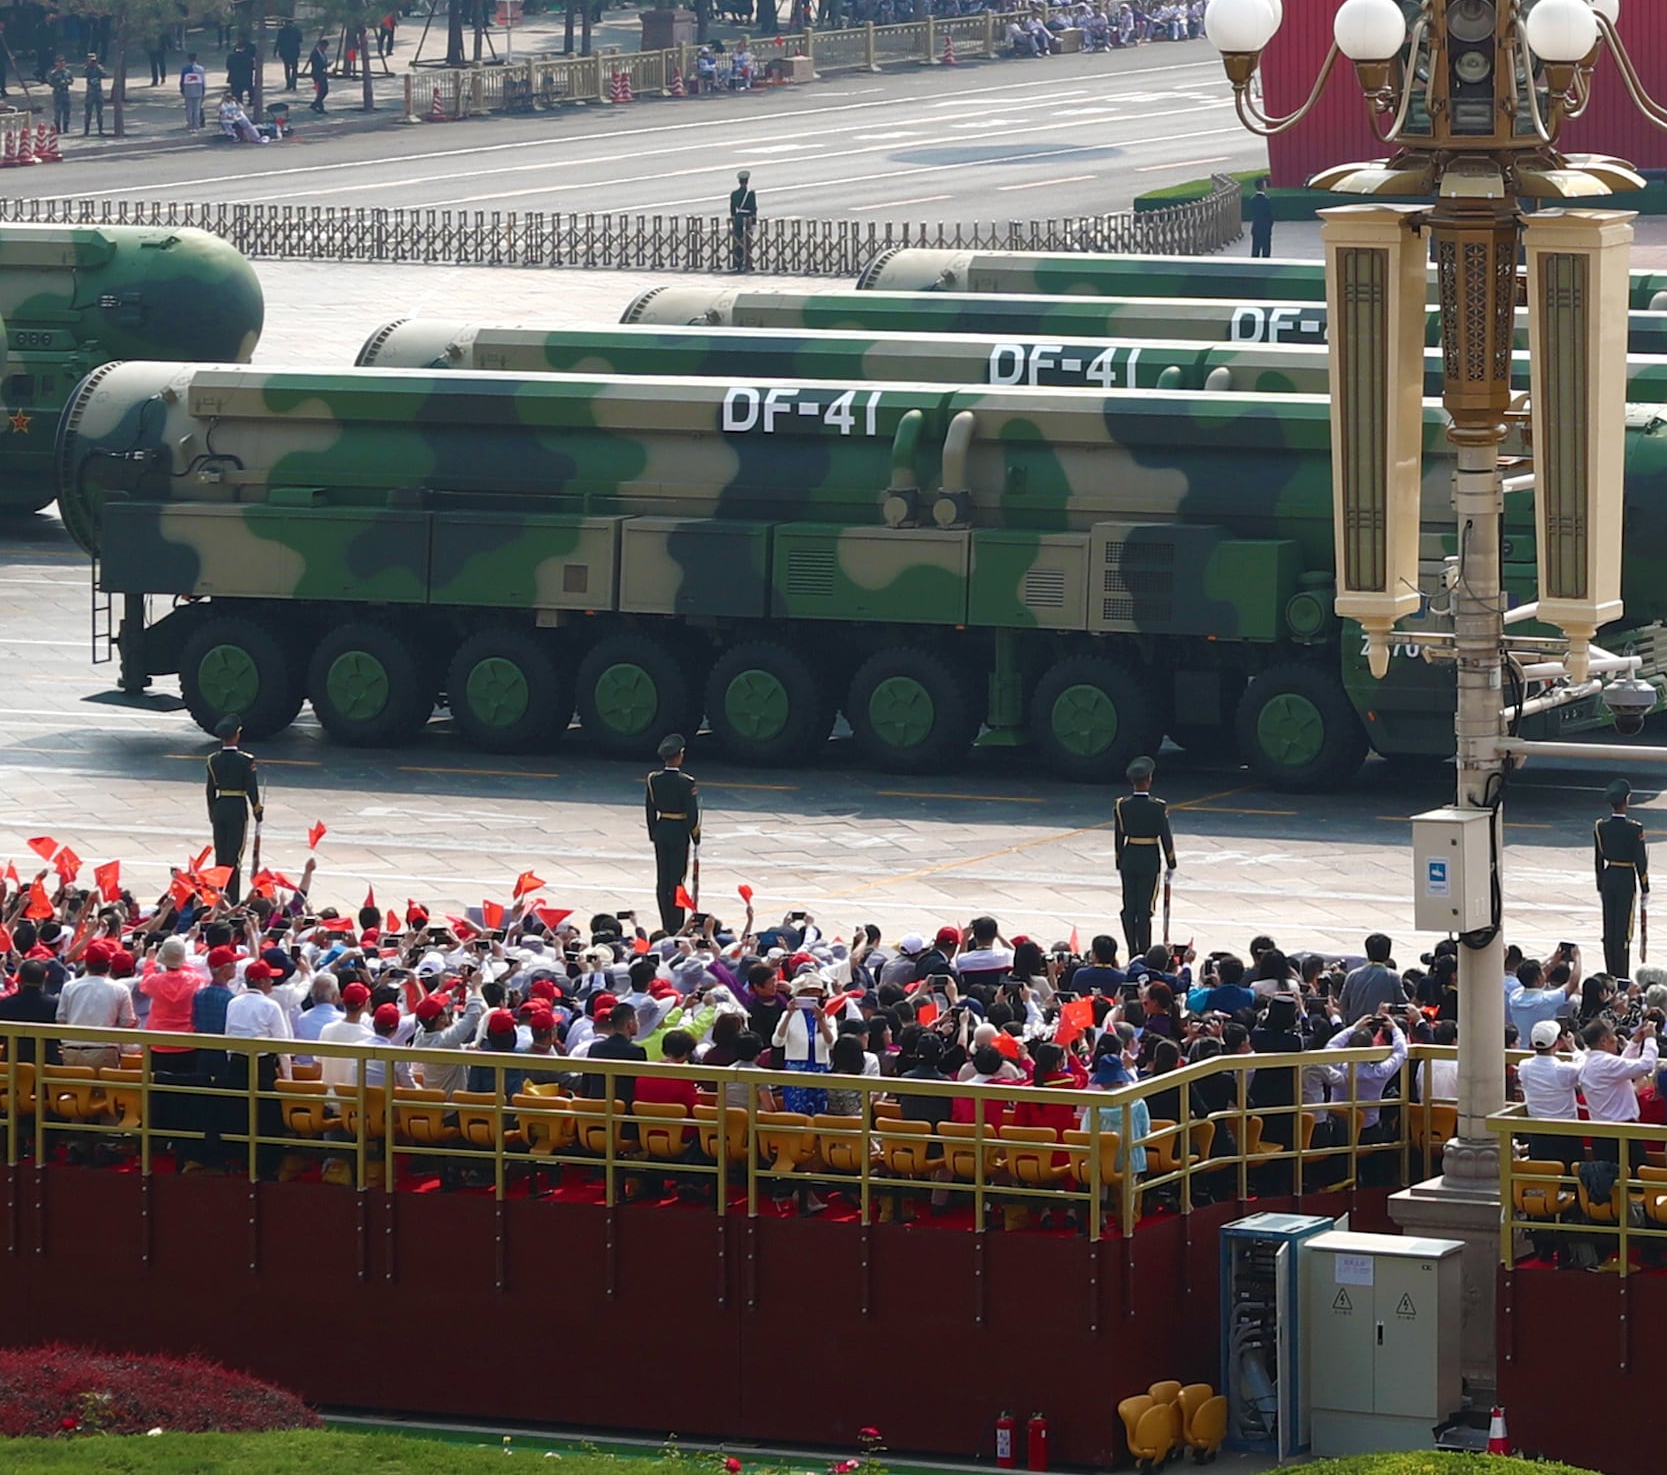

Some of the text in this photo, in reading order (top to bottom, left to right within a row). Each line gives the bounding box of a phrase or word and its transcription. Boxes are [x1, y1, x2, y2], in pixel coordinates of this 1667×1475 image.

[1231, 307, 1328, 343] DF-
[989, 344, 1141, 388] DF-41
[723, 387, 882, 435] DF-41
